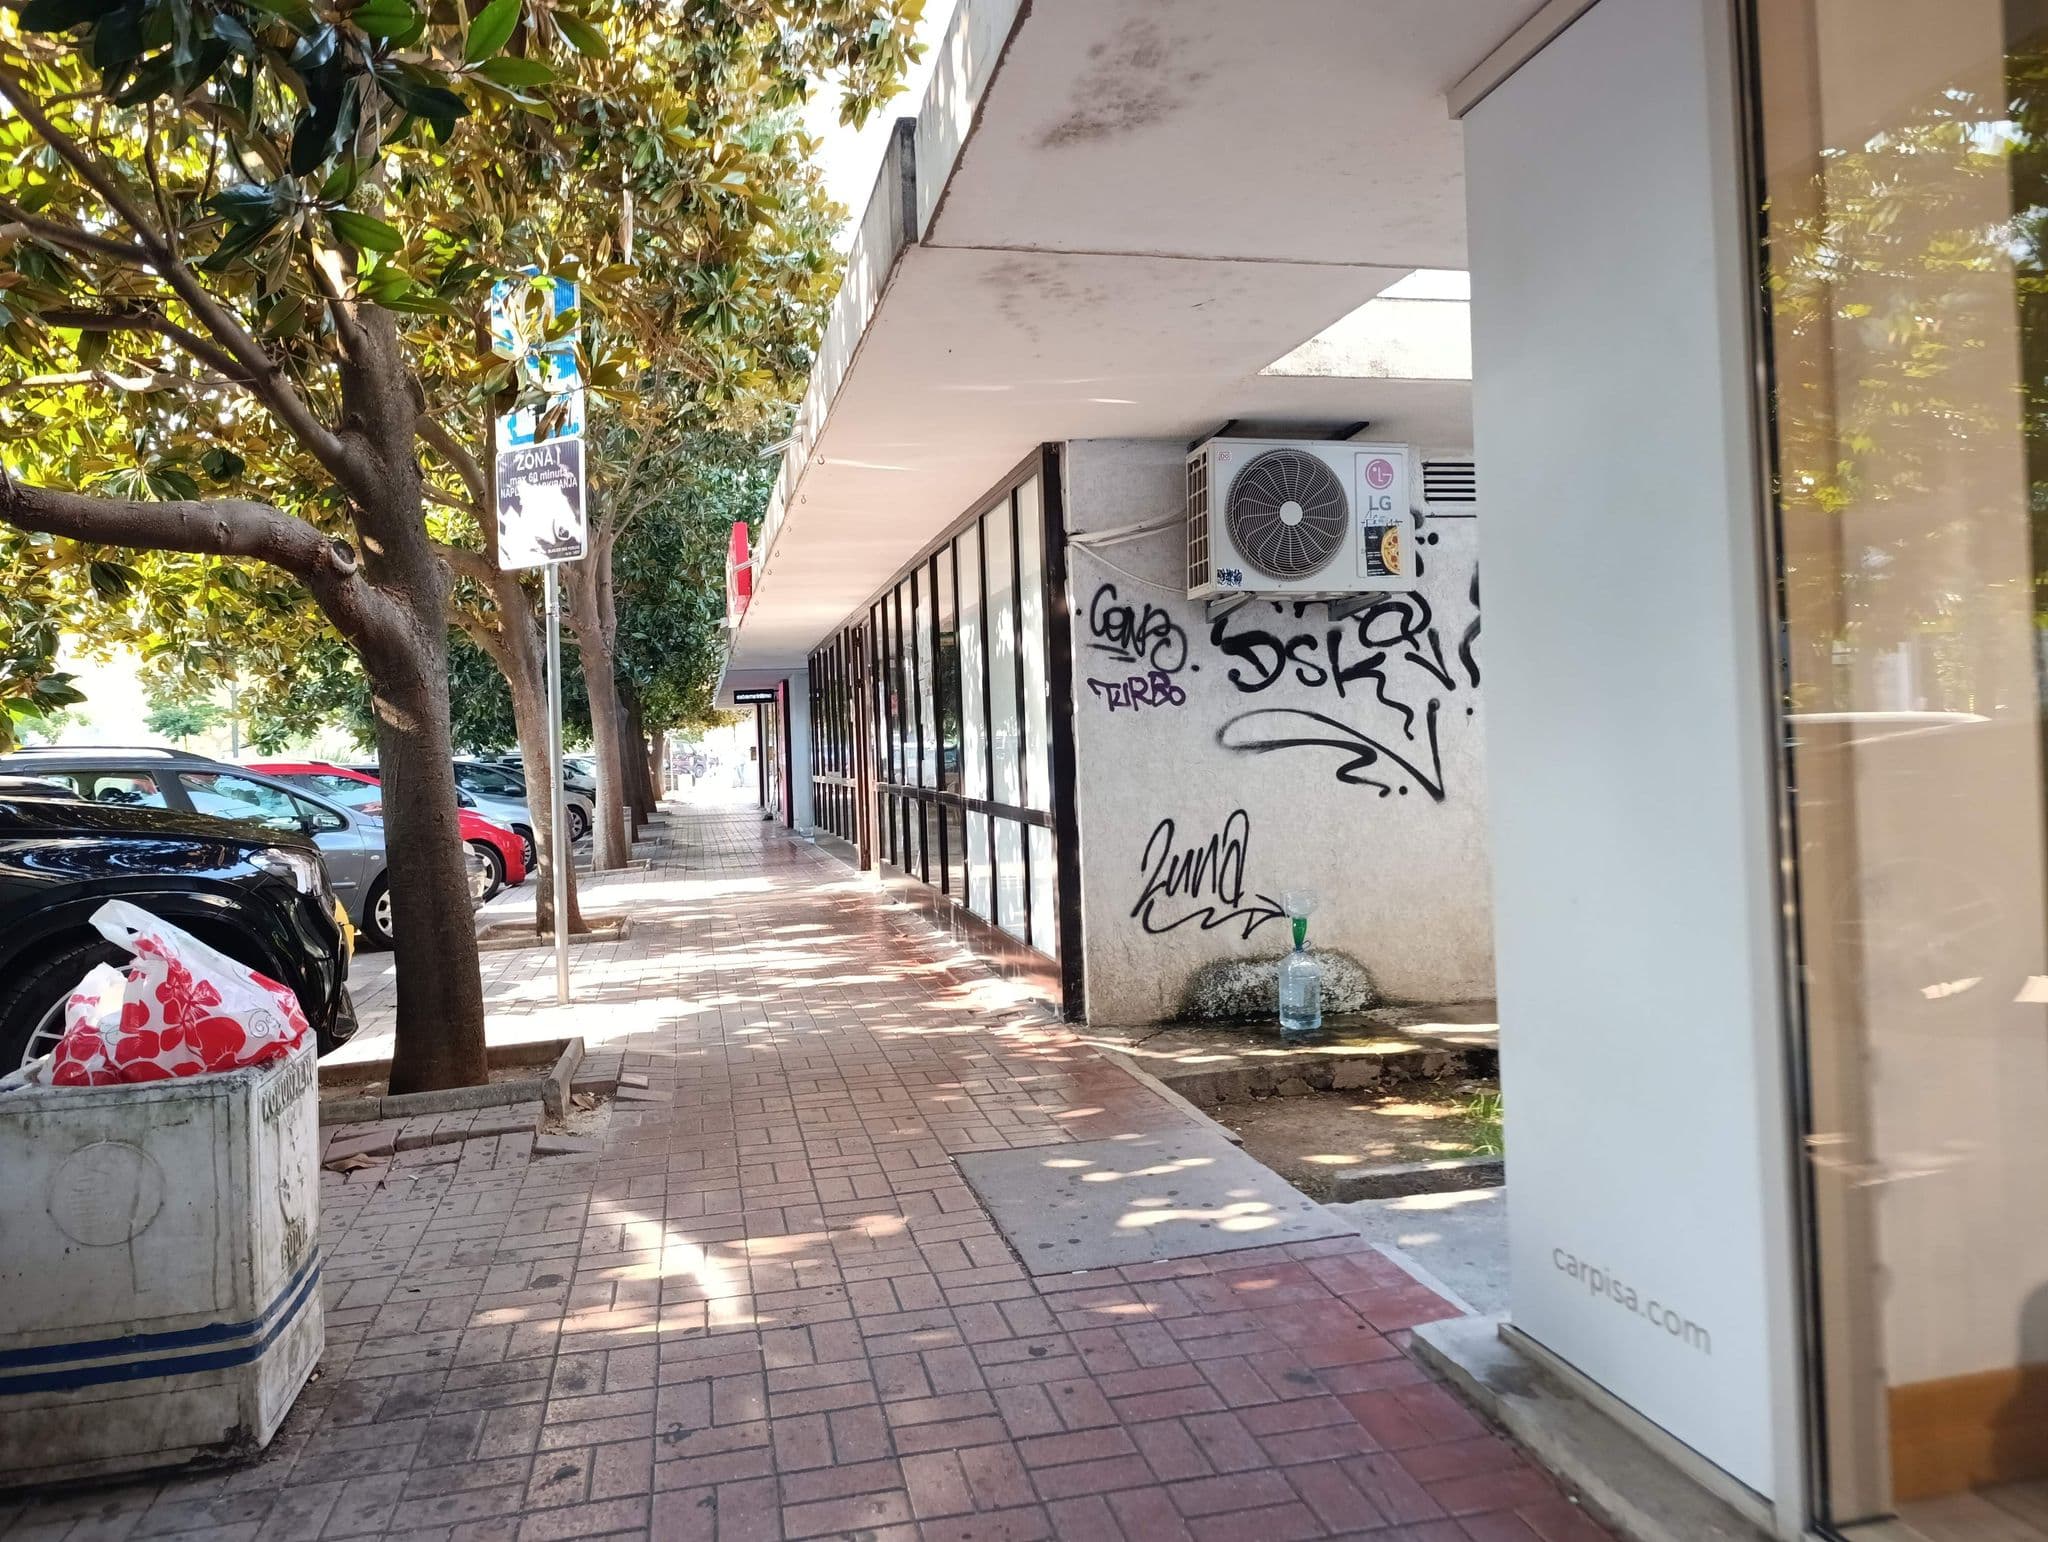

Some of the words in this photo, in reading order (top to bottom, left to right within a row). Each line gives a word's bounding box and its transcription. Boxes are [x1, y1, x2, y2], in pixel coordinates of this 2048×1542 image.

[517, 449, 554, 471] ZONA
[1369, 495, 1392, 511] LG
[1552, 1247, 1712, 1355] carpisa.com
